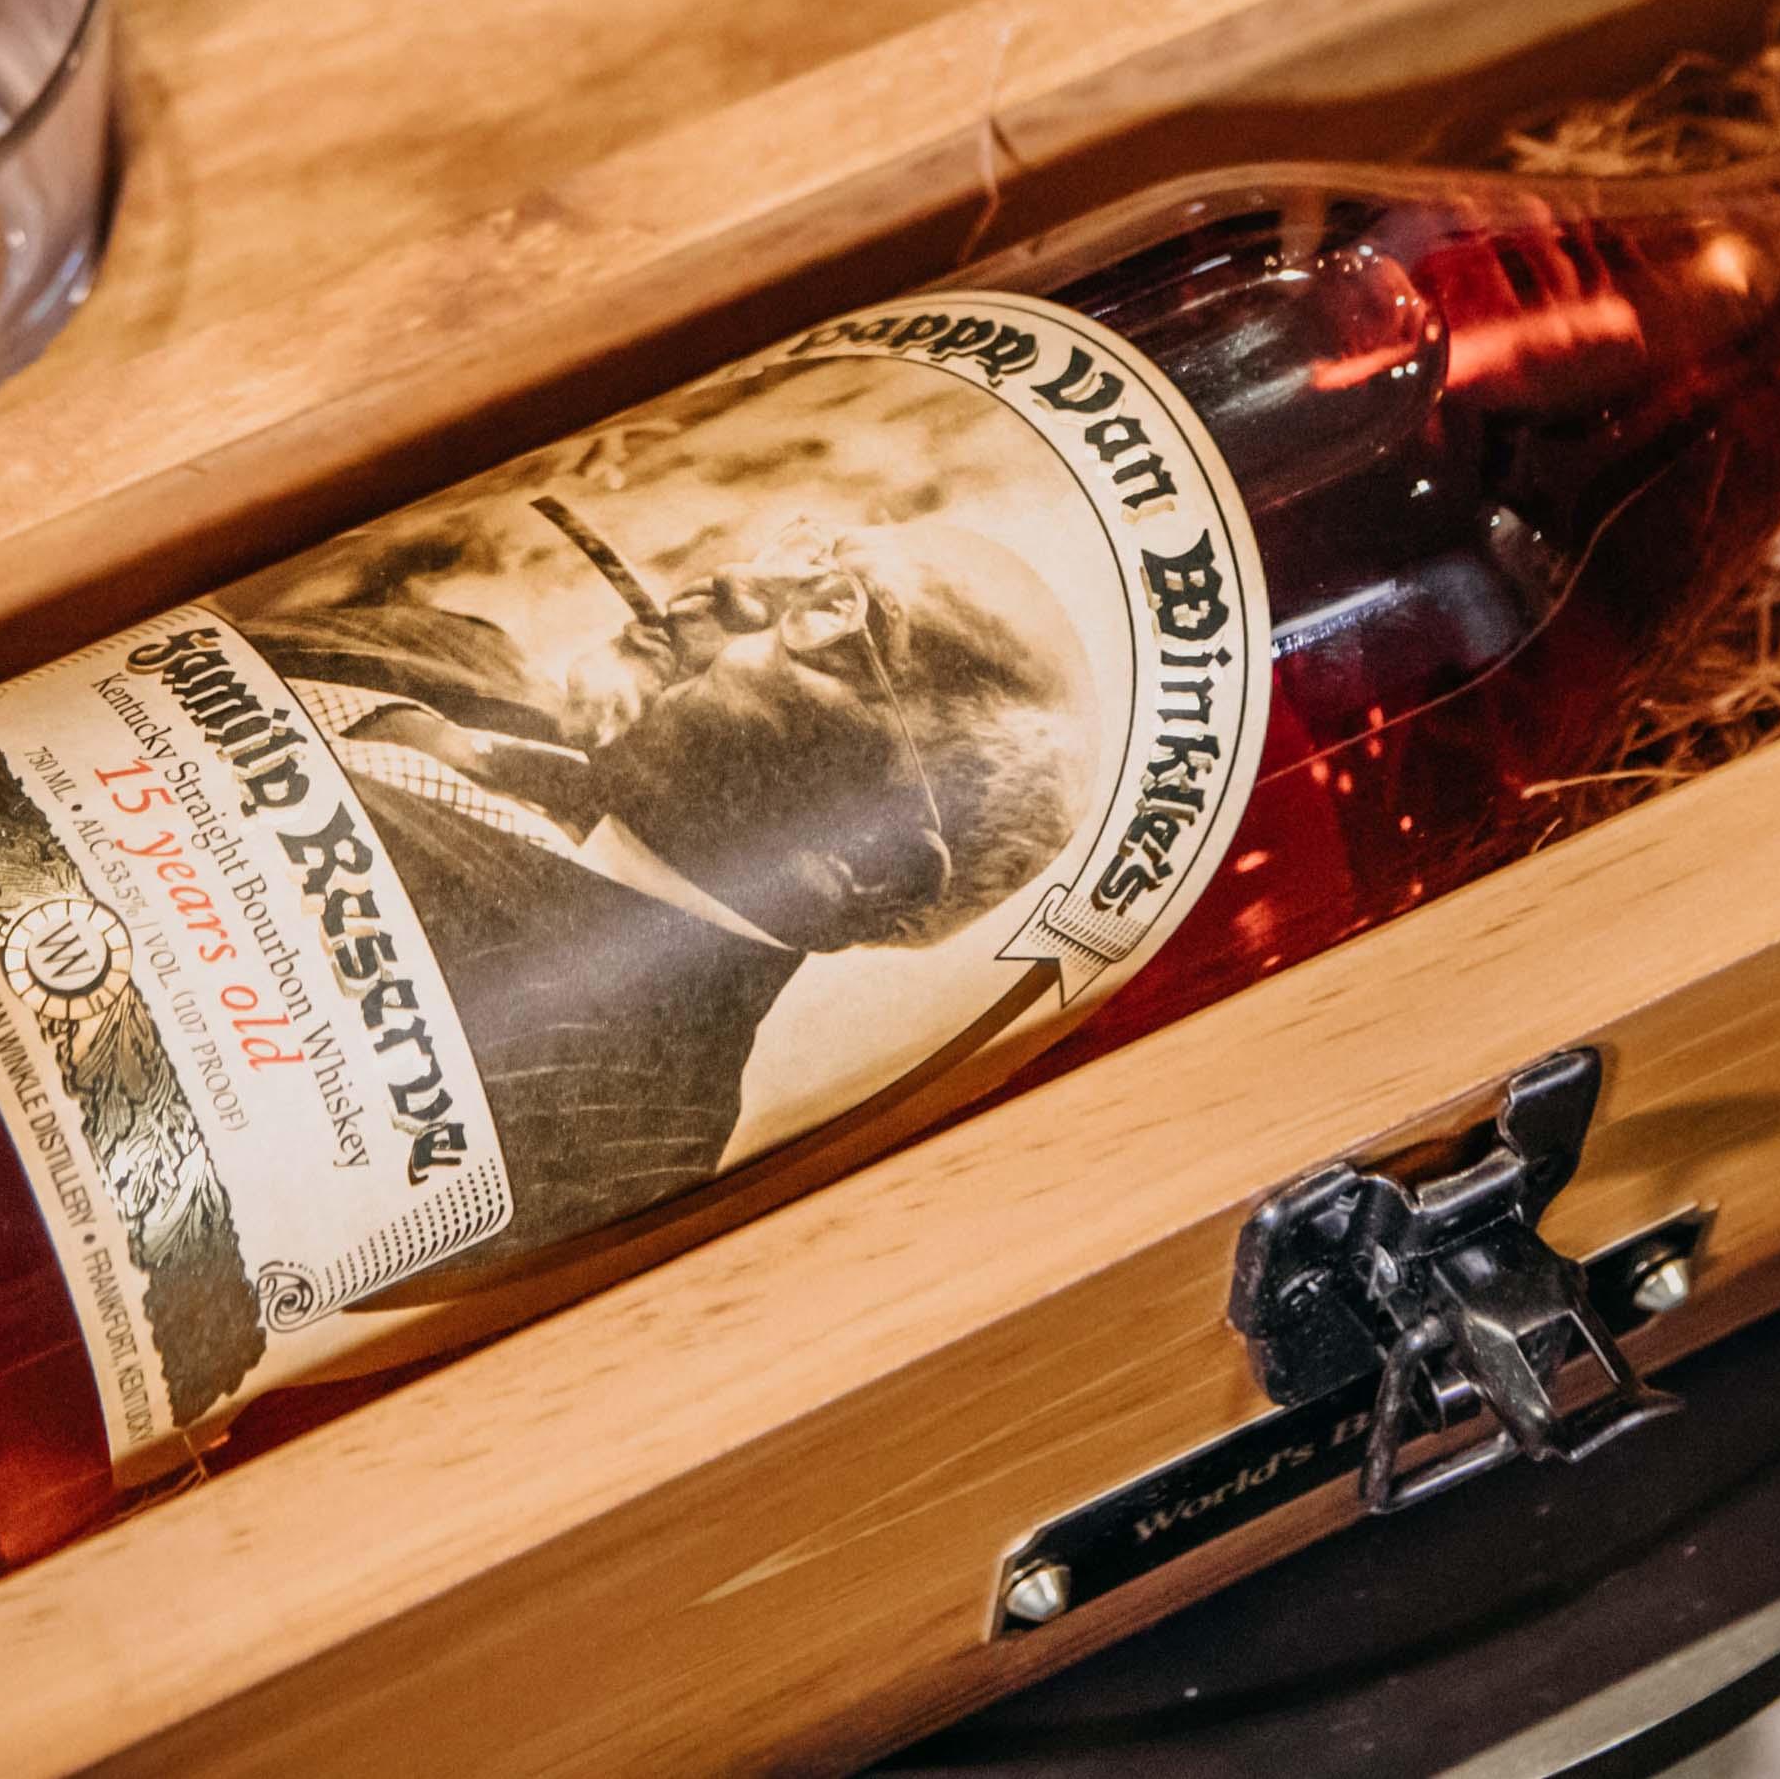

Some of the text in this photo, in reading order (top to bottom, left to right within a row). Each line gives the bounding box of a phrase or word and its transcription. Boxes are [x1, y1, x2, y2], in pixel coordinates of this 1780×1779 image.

[1032, 346, 1178, 524] Van
[1091, 528, 1233, 916] Winkle's
[23, 745, 58, 773] 750
[172, 989, 208, 1036] (107
[191, 1040, 250, 1132] PROOF)
[91, 672, 370, 1168] Kentucky Straight Bourbon Whiskey
[94, 758, 305, 1072] 15 years old
[125, 627, 469, 1186] Family Reserve
[29, 1110, 99, 1229] DISTILLERY
[81, 1246, 139, 1370] FRANKFORT,
[117, 1363, 155, 1446] KENTUCKY
[1132, 1443, 1315, 1544] World's
